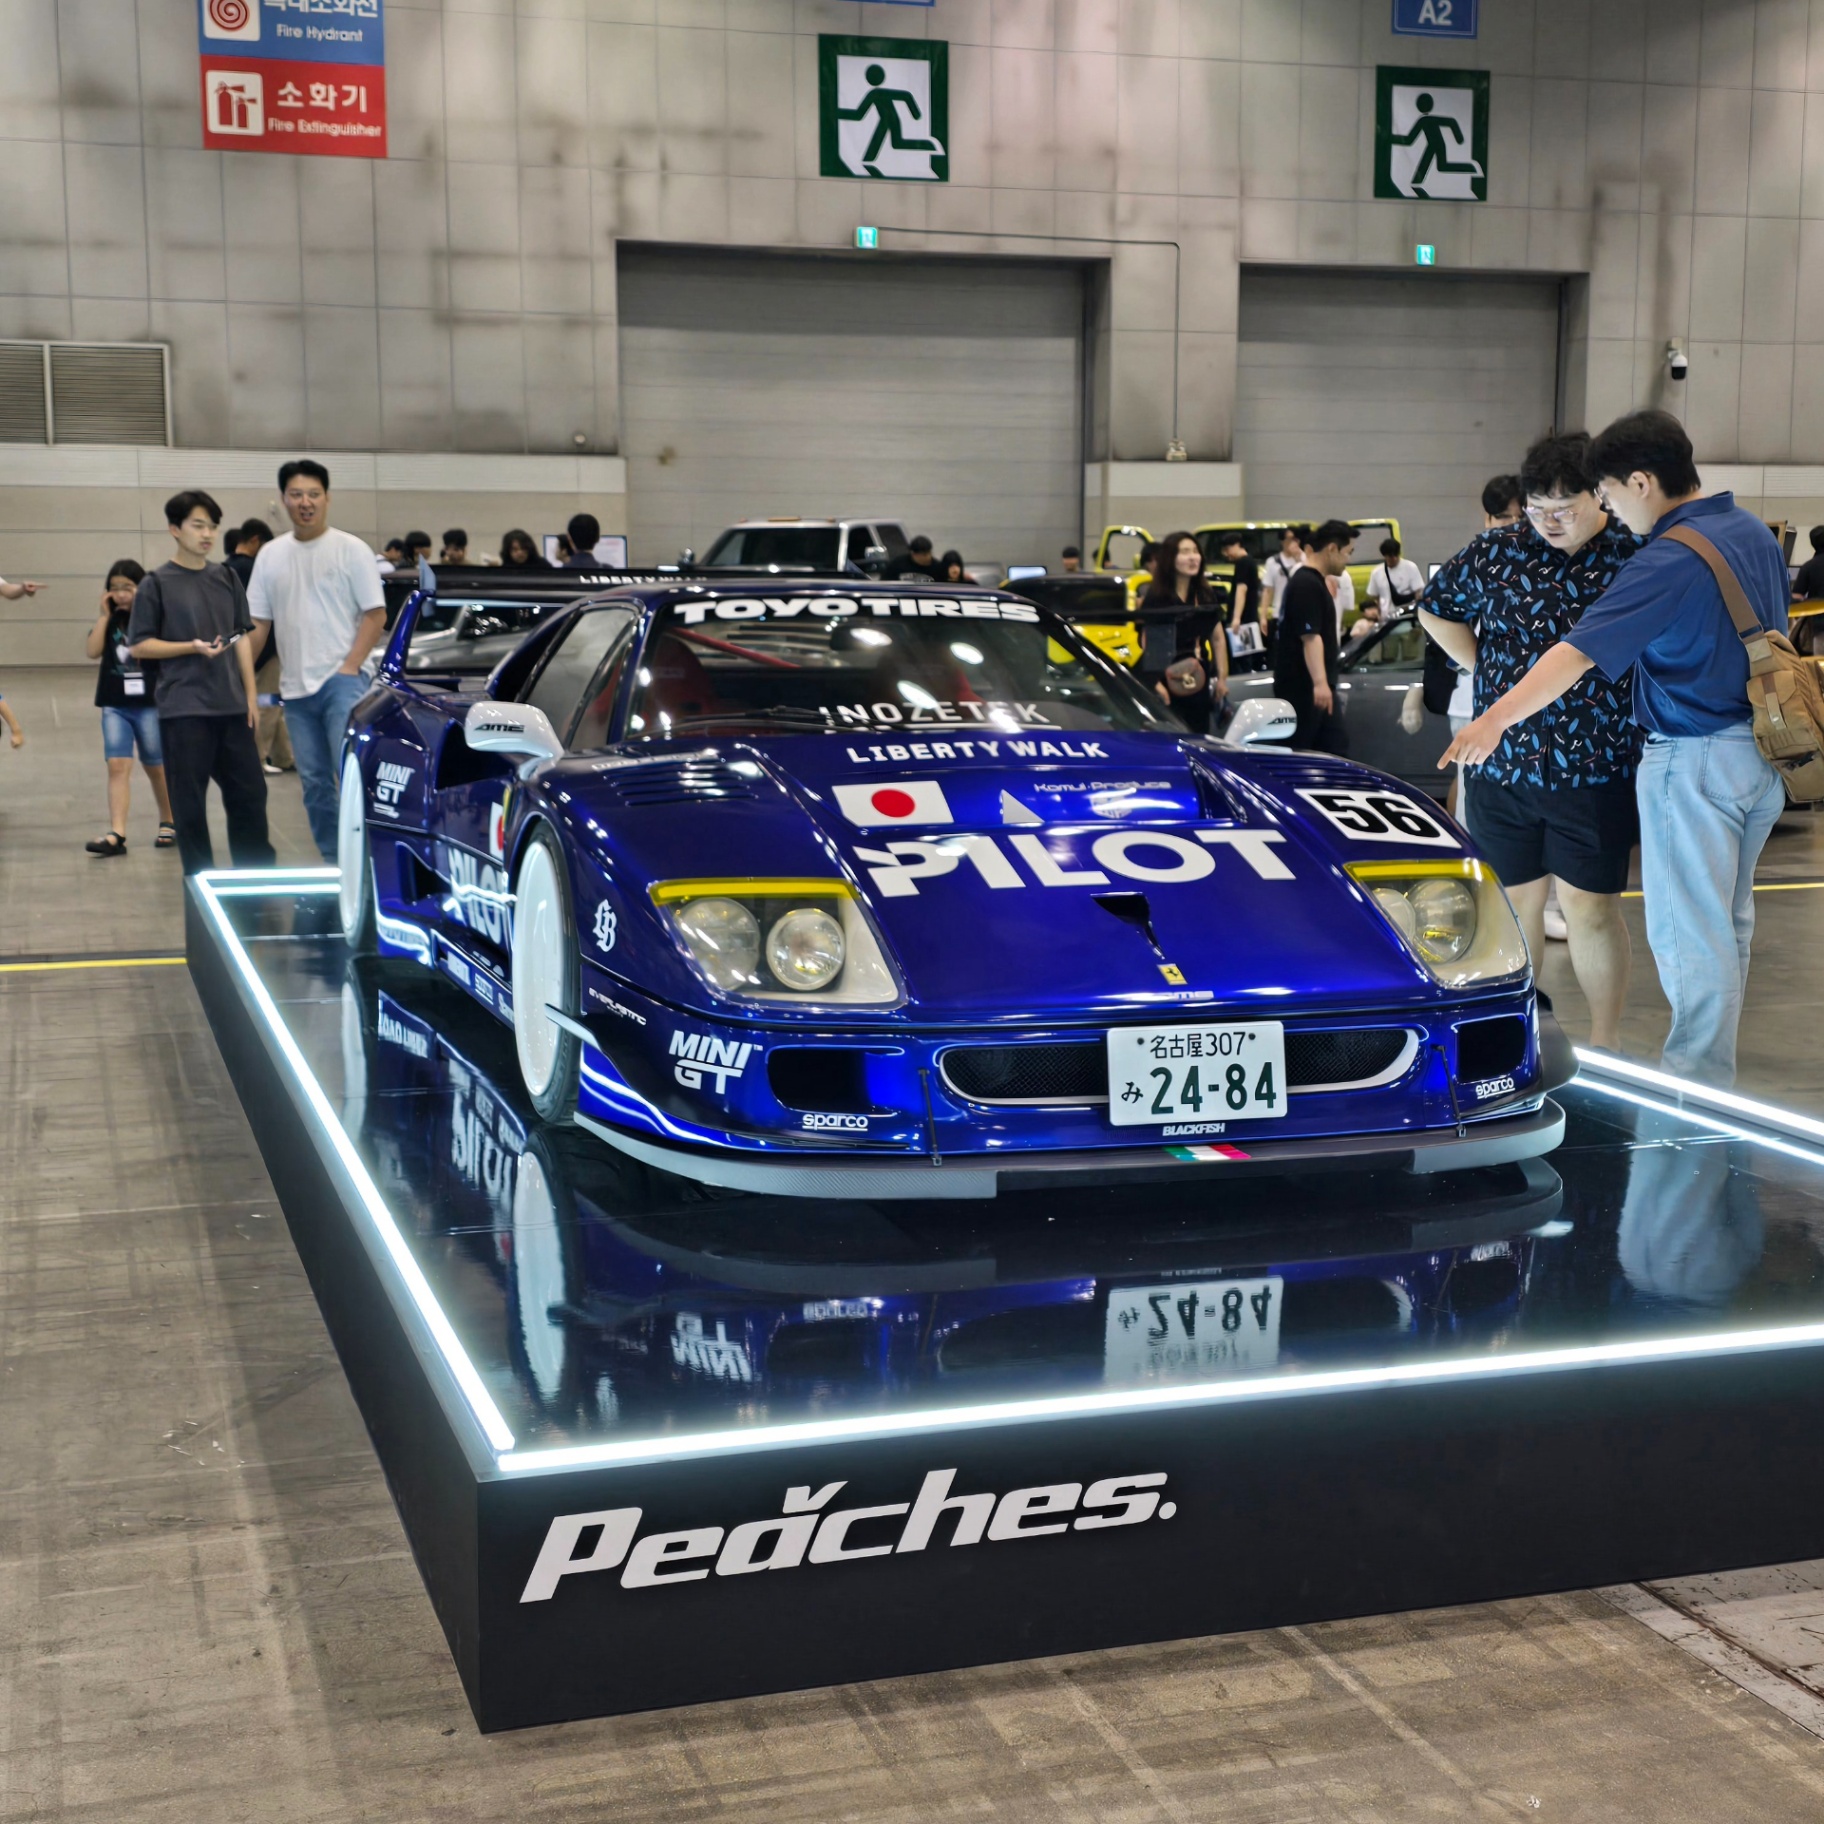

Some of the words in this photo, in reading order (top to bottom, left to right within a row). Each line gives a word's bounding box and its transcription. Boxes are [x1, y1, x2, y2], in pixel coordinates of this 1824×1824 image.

[1418, 0, 1452, 25] A2
[276, 23, 303, 37] Fire
[306, 26, 363, 42] Hydrant
[277, 81, 368, 113] 소화기
[267, 117, 295, 132] Fire
[674, 598, 858, 624] TOYO
[861, 598, 1040, 623] TIRES
[846, 741, 999, 763] LIBERTY
[1006, 740, 1109, 759] WALK
[376, 761, 412, 786] MINI
[1308, 794, 1441, 838] 56
[852, 830, 1297, 897] PILOT
[668, 1029, 753, 1070] MINI
[674, 1059, 744, 1095] GT
[1149, 1061, 1277, 1115] 24-84
[1475, 1077, 1515, 1099] sparco
[802, 1113, 868, 1131] sparco
[1162, 1123, 1226, 1137] BLACKFISH
